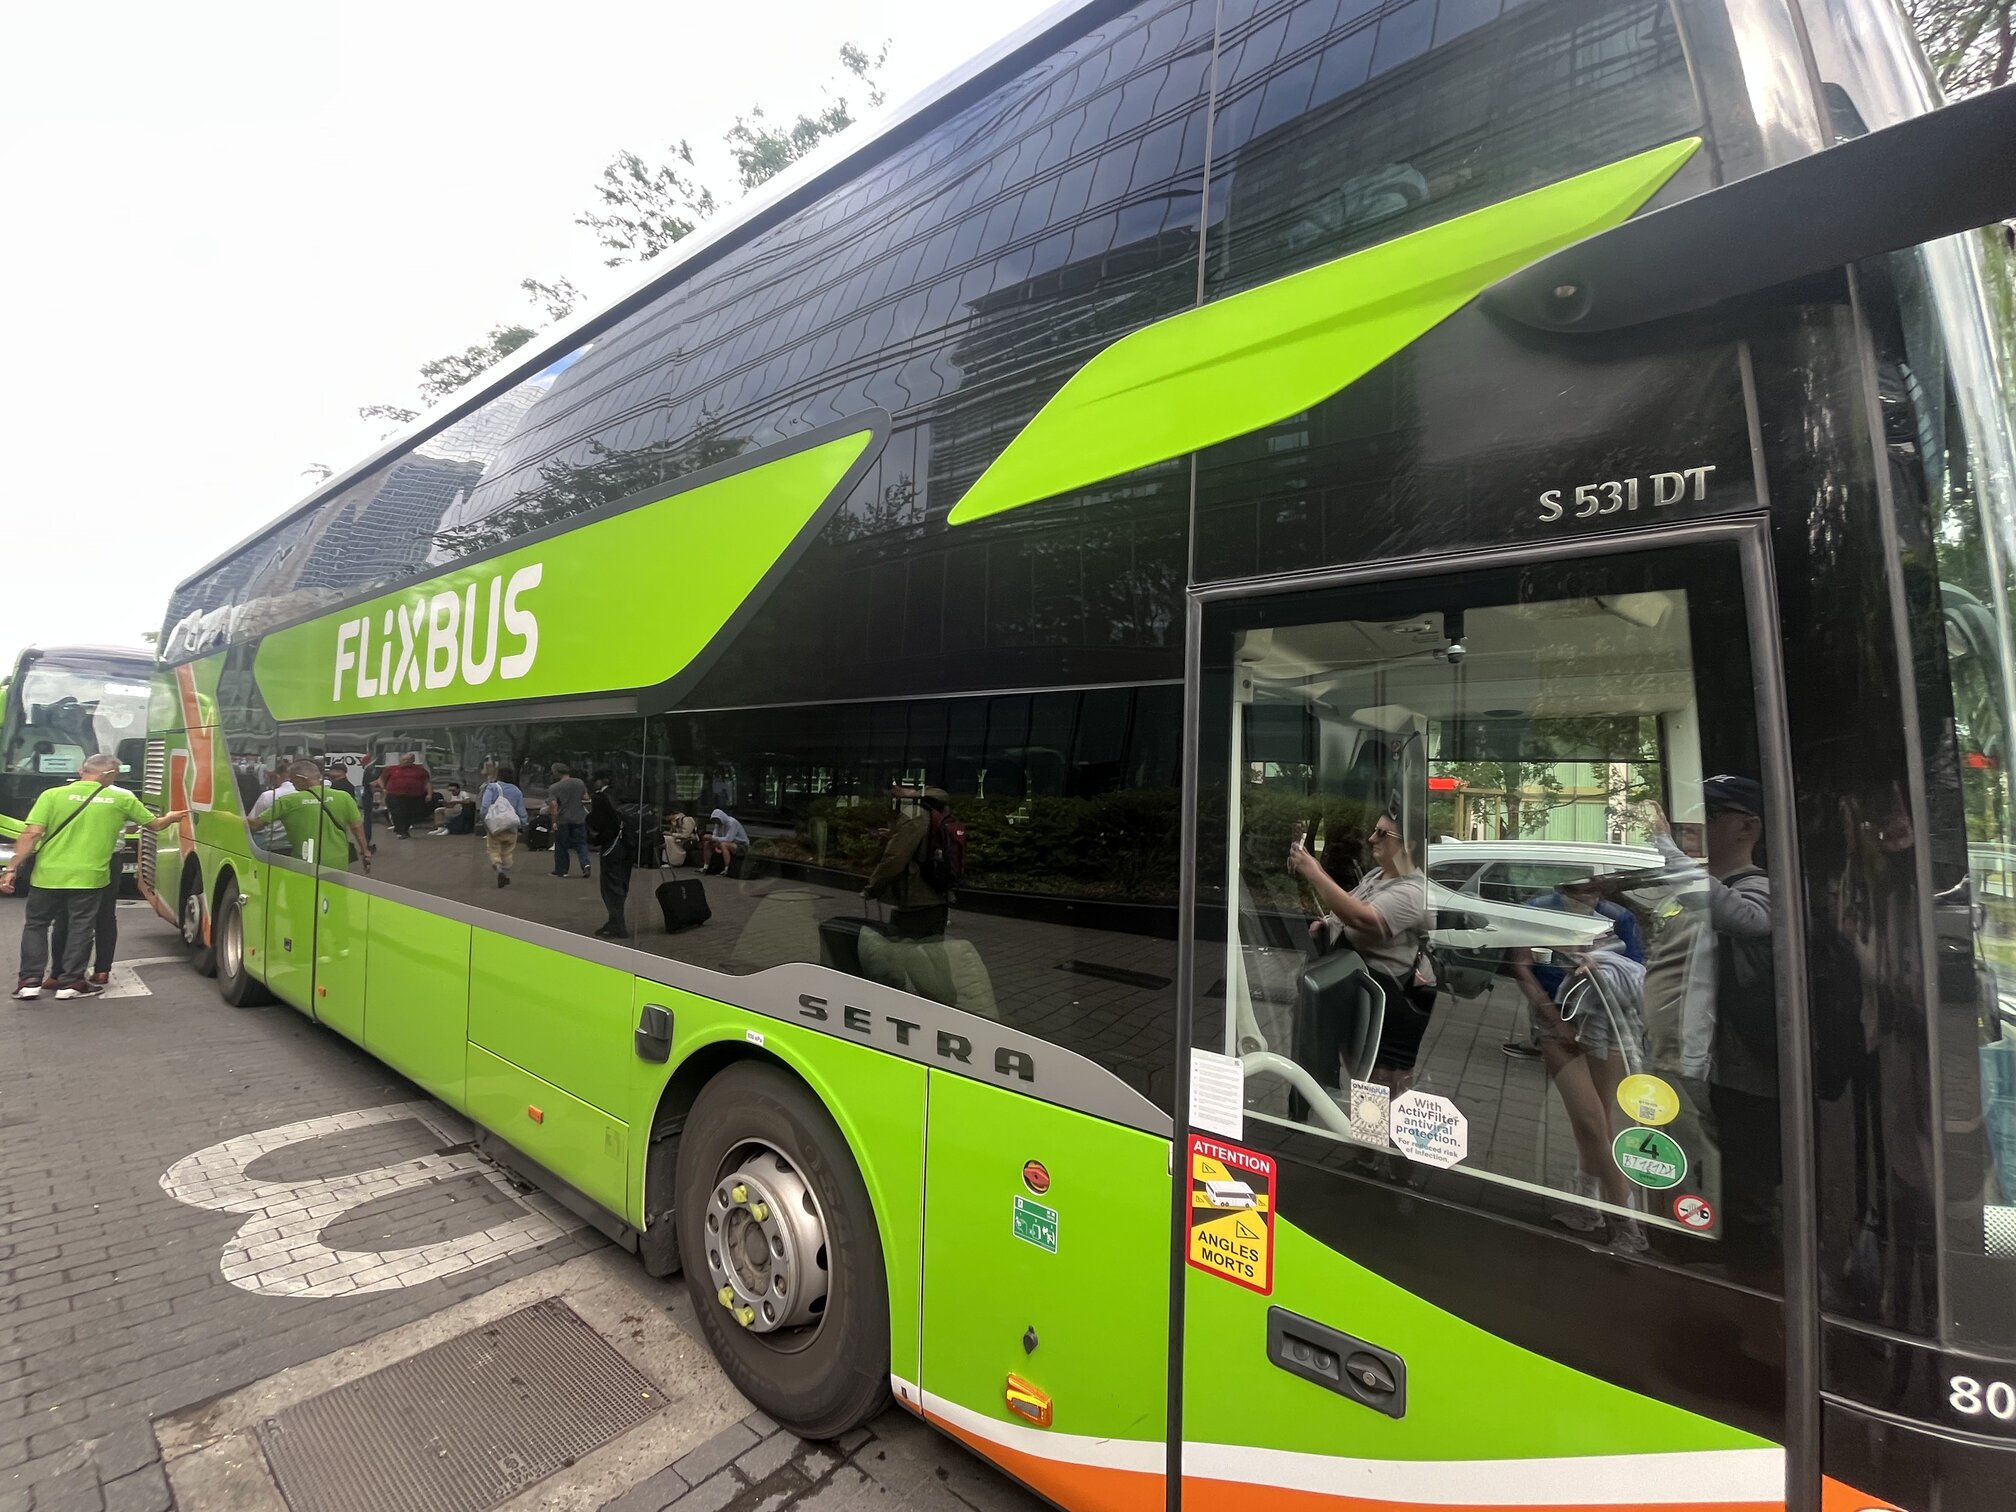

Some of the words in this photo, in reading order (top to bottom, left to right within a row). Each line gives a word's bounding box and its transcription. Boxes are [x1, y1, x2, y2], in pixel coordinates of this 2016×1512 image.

[1538, 489, 1564, 522] S
[1575, 478, 1639, 518] 531
[1650, 465, 1716, 507] DT
[798, 993, 1035, 1083] SETRA
[1398, 1104, 1460, 1126] ActivFilter
[1414, 1097, 1442, 1112] With
[1396, 1125, 1461, 1147] protection.
[1404, 1117, 1453, 1135] antiviral
[1193, 1140, 1270, 1174] ATTENTION
[1398, 1137, 1410, 1146] For
[1412, 1140, 1442, 1153] reduced
[1443, 1147, 1459, 1158] risk
[1639, 1132, 1660, 1159] 4
[1198, 1230, 1259, 1262] ANGLES
[1201, 1247, 1254, 1278] MORTS
[1949, 1375, 2016, 1420] 80
